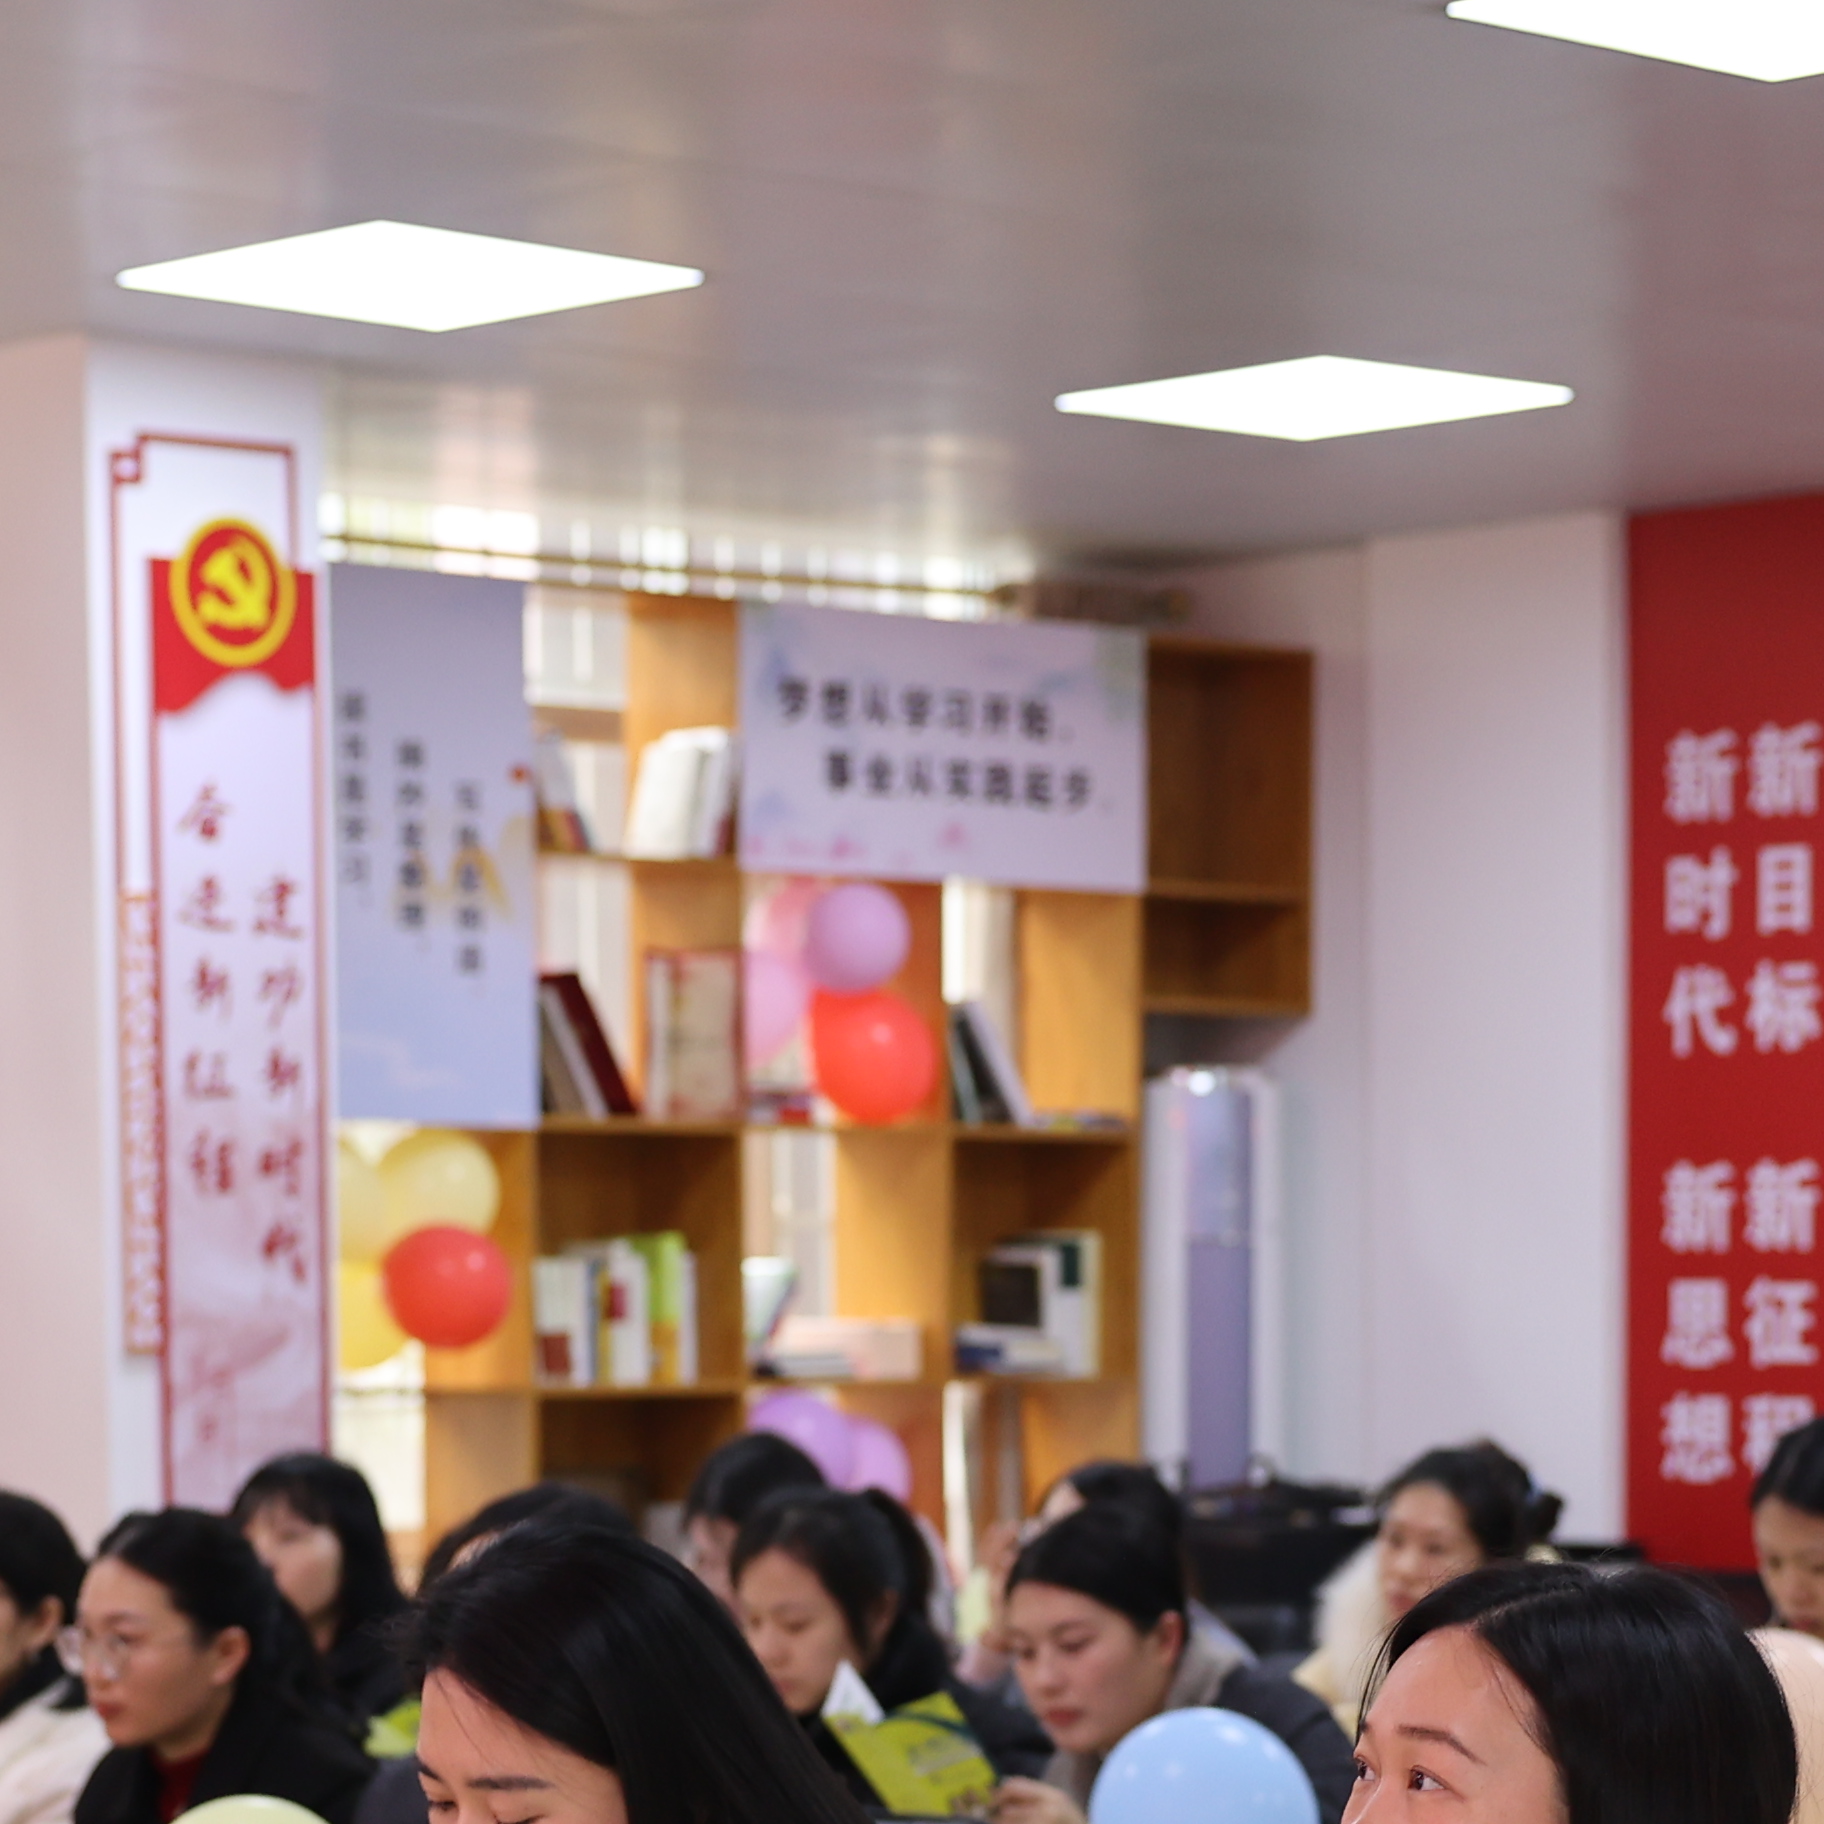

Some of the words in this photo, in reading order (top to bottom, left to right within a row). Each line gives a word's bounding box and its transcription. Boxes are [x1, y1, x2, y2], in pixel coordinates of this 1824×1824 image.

[1663, 729, 1740, 1058] 新时代
[1746, 720, 1824, 1054] 新目标
[1660, 1158, 1736, 1486] 新思想
